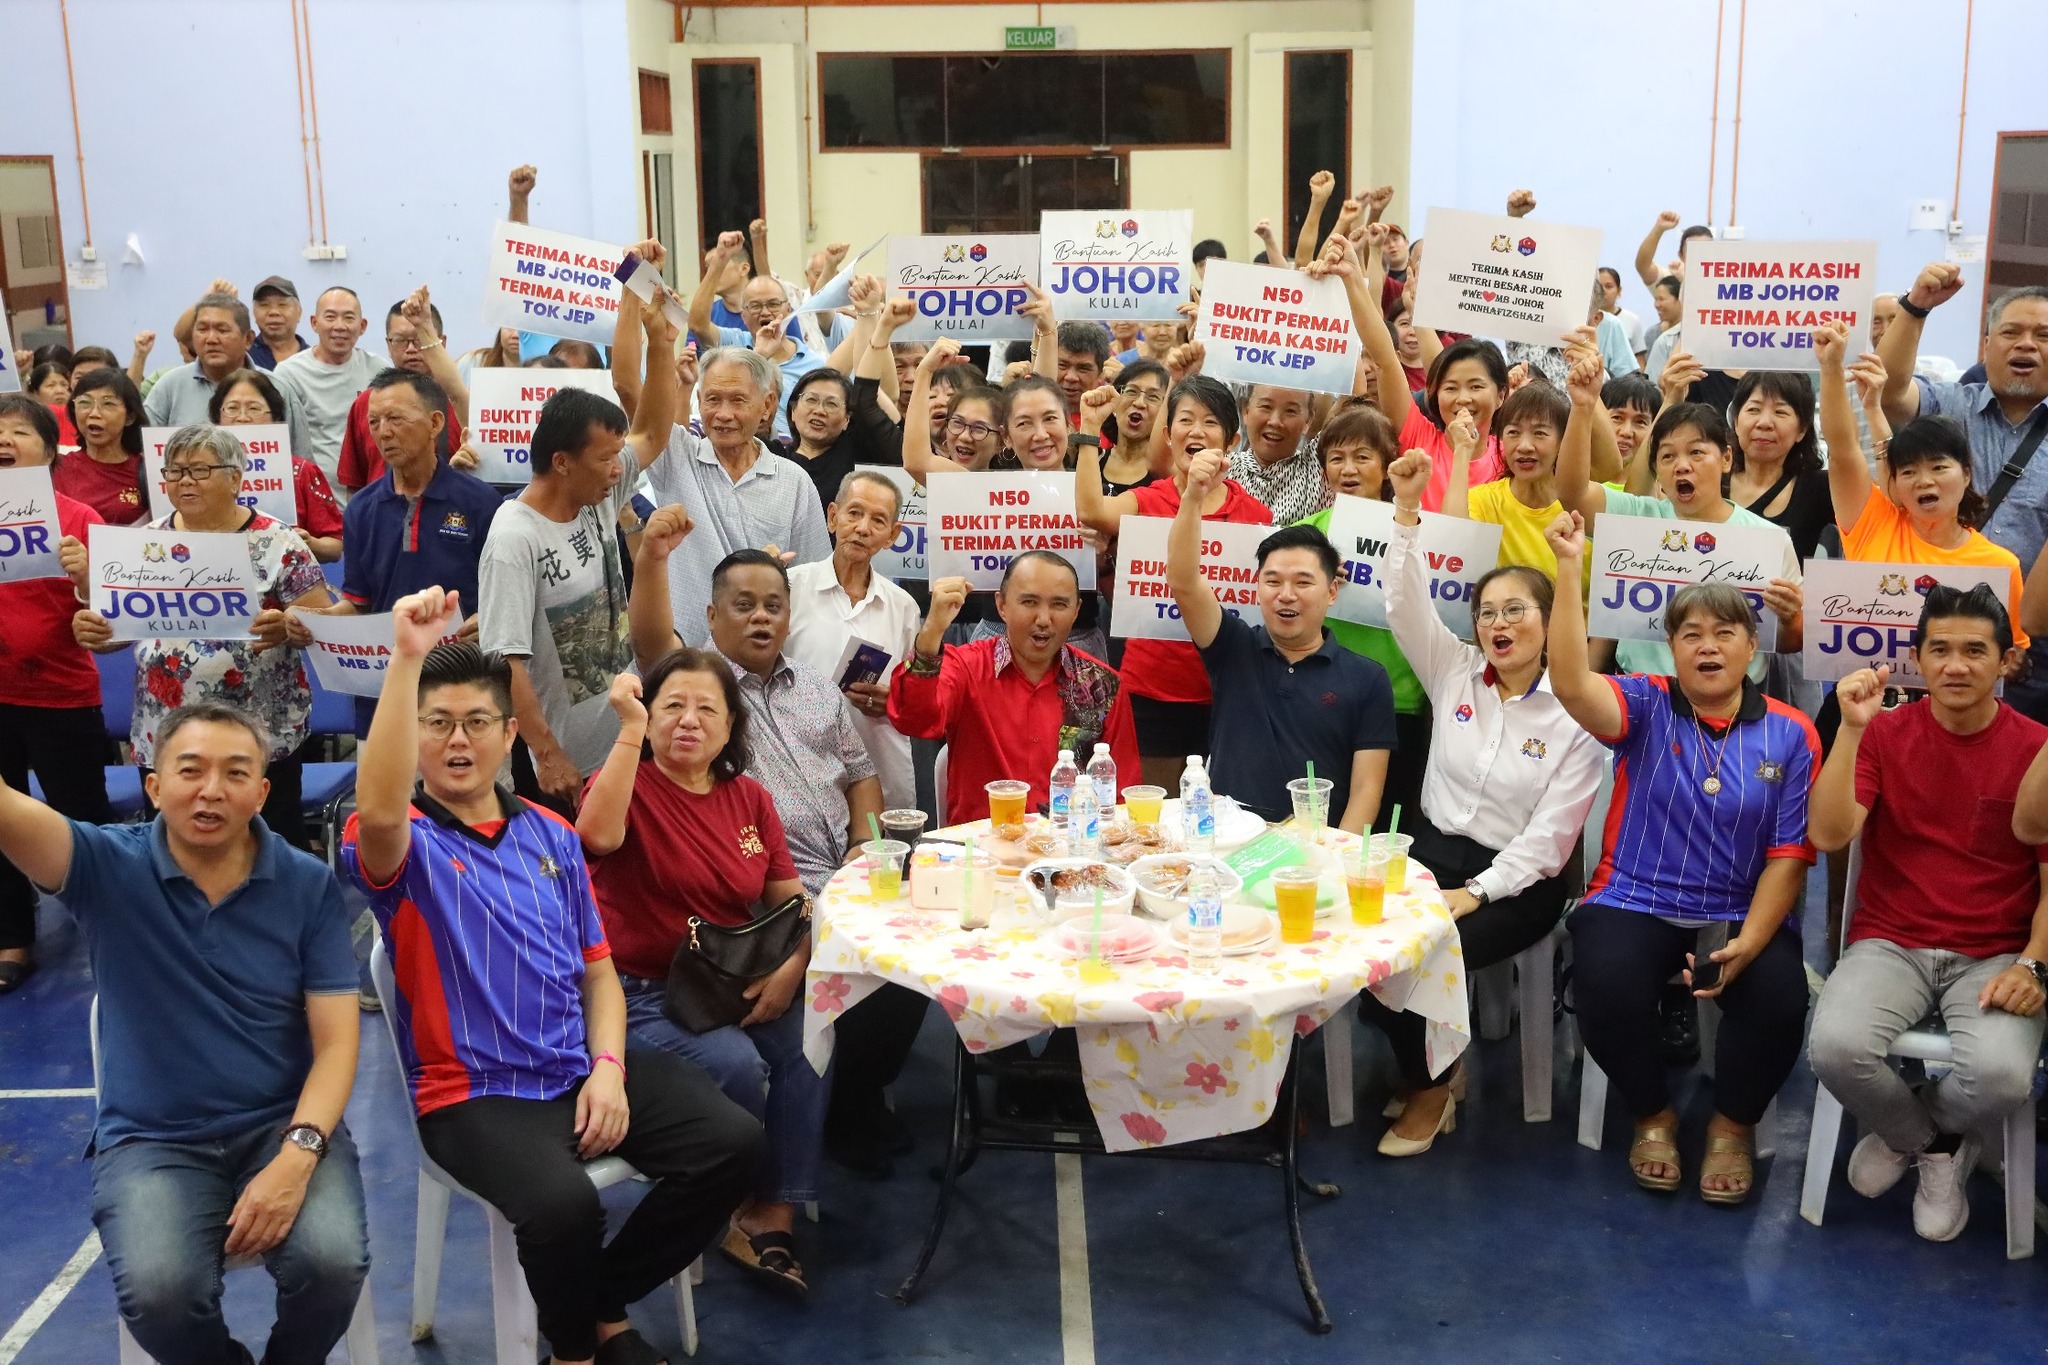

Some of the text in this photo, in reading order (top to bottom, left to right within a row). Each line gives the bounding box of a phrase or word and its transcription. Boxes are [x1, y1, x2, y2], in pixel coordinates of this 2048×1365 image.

[1007, 31, 1054, 46] KELUAR
[505, 239, 570, 265] TERIMA
[1054, 240, 1178, 262] Bantuan Kasih
[516, 260, 612, 291] MB JOHOR
[900, 265, 1026, 286] Bantuan Kasih
[1471, 262, 1544, 282] TERIMA KASIH
[1700, 261, 1861, 279] TERIMA KASIH
[1051, 266, 1180, 294] JOHOR
[1448, 273, 1563, 298] MENTERI BESAR JOHOR
[499, 277, 565, 303] TERIMA
[1263, 286, 1304, 305] N50
[1717, 283, 1840, 301] MB JOHOR
[908, 289, 1028, 317] OHOR
[1089, 297, 1138, 309] KULAI
[1512, 297, 1545, 310] JOHOR
[523, 300, 595, 325] TOK JEP
[1212, 302, 1350, 334] BUKIT PERMAI
[1458, 302, 1545, 323] #ONNHAFIZGHAZI
[1697, 309, 1781, 327] TERIMA
[934, 319, 985, 330] KULAI
[1209, 322, 1348, 355] TERIMA KASIH
[1728, 331, 1776, 348] TOK
[1234, 346, 1316, 370] TOK JEP
[480, 409, 532, 424] BUKIT
[479, 429, 531, 444] TERIM
[503, 449, 531, 464] TO
[241, 479, 283, 492] ASIH
[237, 496, 258, 507] EP
[989, 490, 1031, 506] N50
[941, 515, 1002, 530] BUKIT
[941, 535, 1017, 551] TERIMA
[1020, 535, 1084, 549] KASIH
[1201, 540, 1223, 557] 50
[102, 561, 240, 588] Bantuan Kasih
[1608, 549, 1764, 582] Bantuan Kasih
[100, 590, 250, 620] JOHOR
[1155, 603, 1182, 620] TO
[1823, 595, 1913, 622] Bantuan
[148, 620, 207, 631] KULAI
[316, 640, 392, 657] TERIMA
[1819, 625, 1918, 659] JOH
[337, 657, 370, 670] MB
